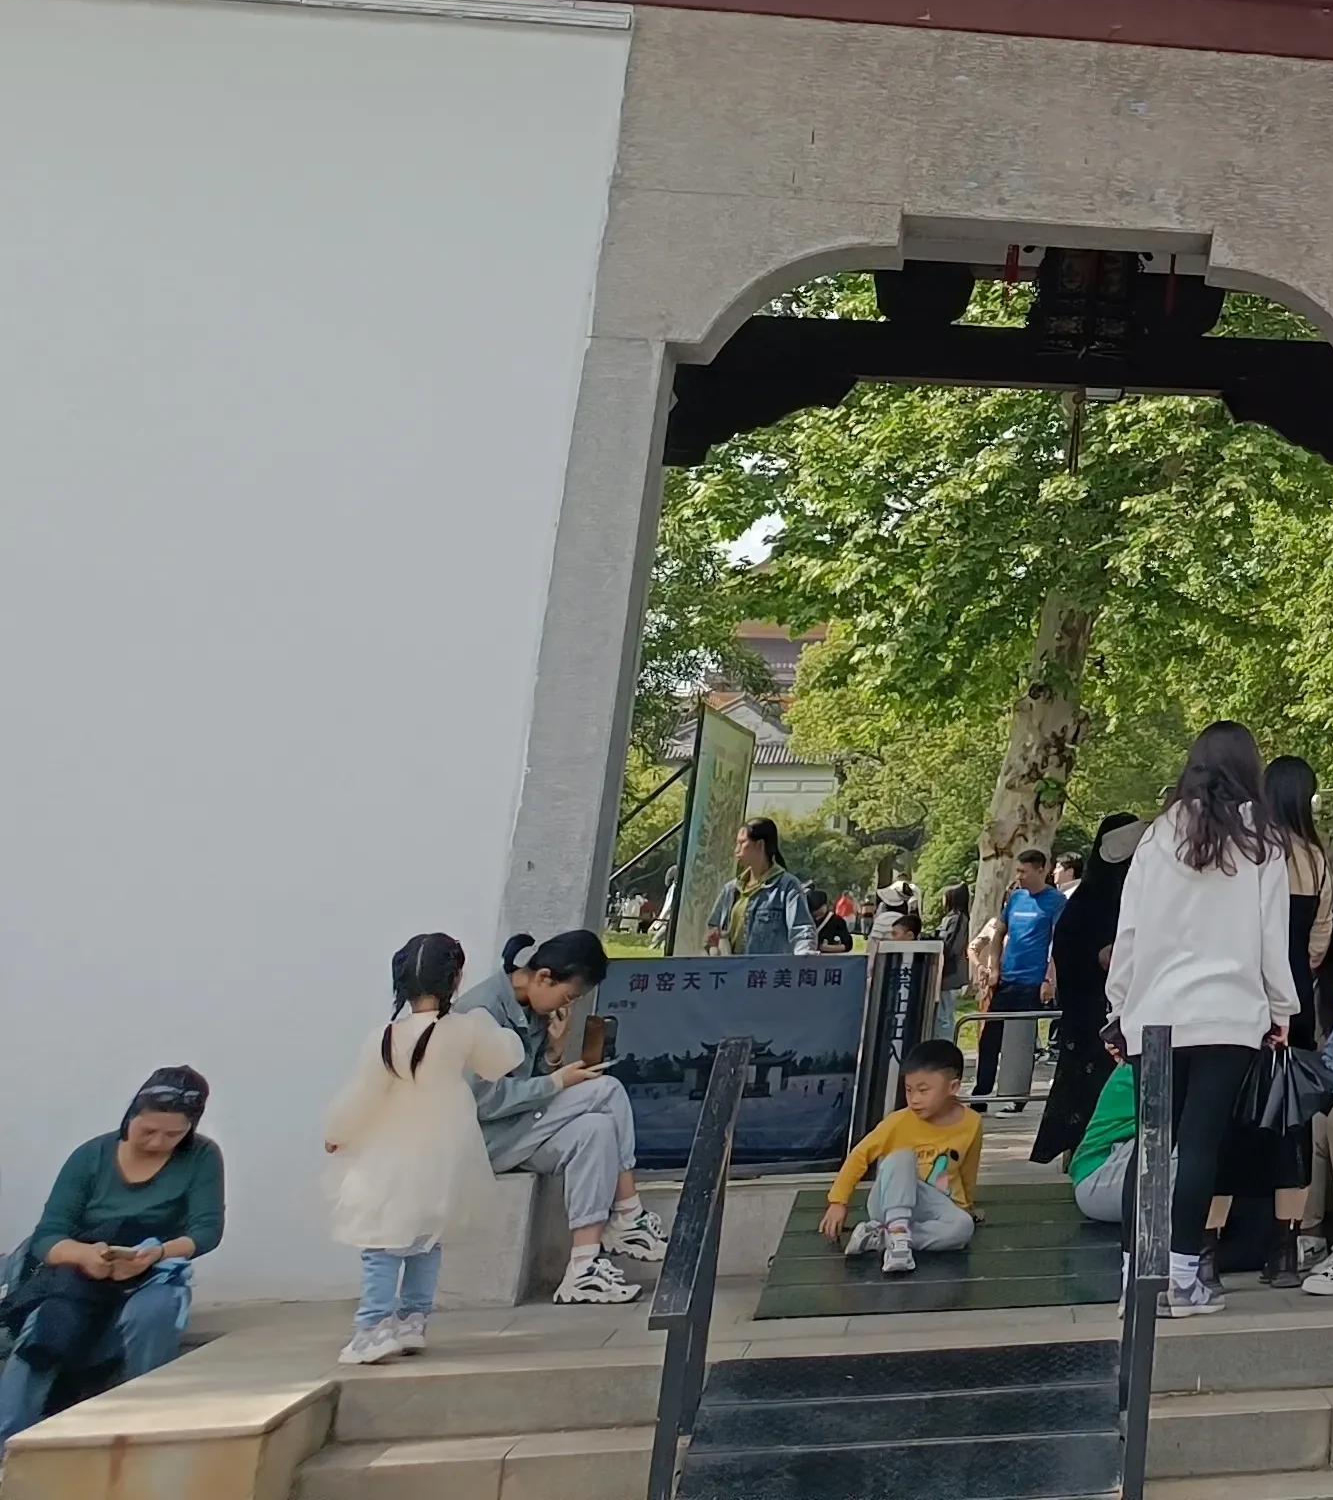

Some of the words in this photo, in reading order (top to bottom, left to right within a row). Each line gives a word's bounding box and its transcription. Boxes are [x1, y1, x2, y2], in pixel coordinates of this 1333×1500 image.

[629, 971, 728, 993] 御窑天下
[746, 968, 843, 989] 醉美陶阳
